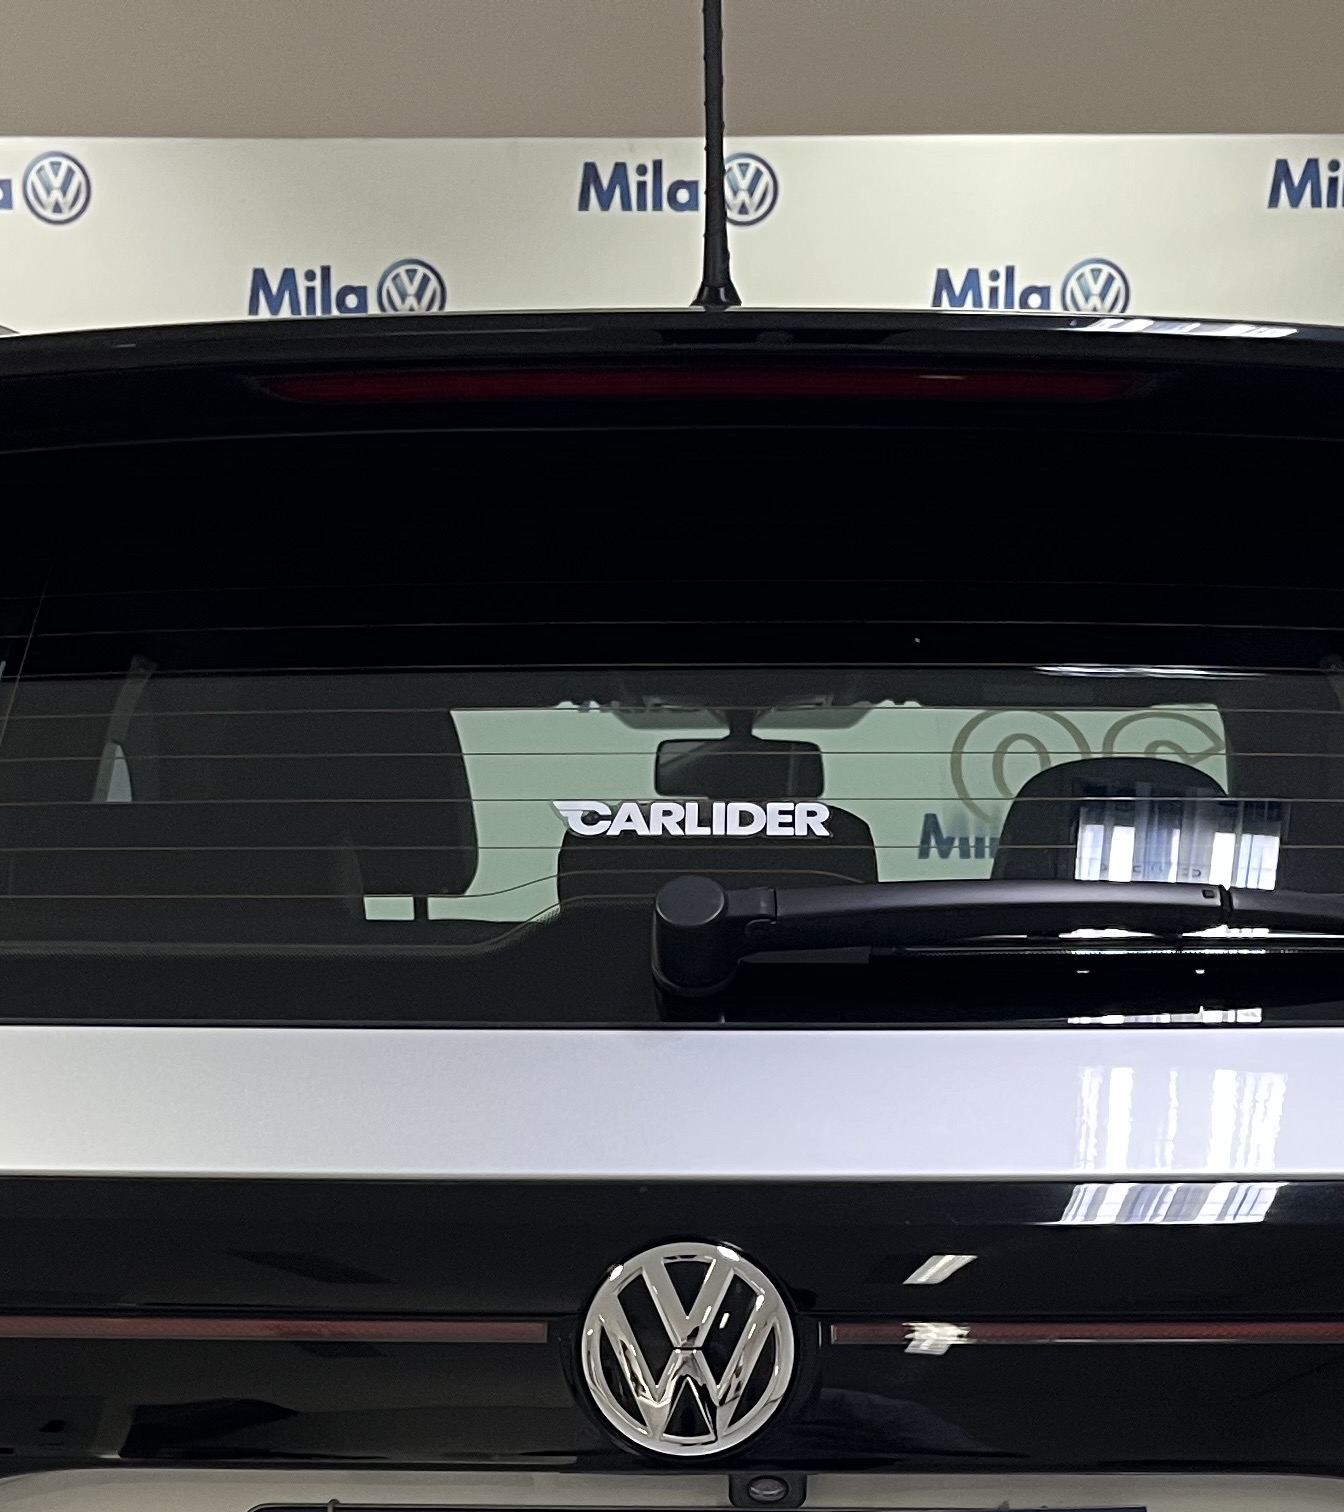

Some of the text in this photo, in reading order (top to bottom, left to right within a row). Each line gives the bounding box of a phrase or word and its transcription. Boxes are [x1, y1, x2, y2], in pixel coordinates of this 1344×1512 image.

[578, 159, 701, 214] Mila
[248, 264, 368, 316] Mila
[931, 264, 1052, 311] Mila
[553, 800, 832, 837] CARLIDER
